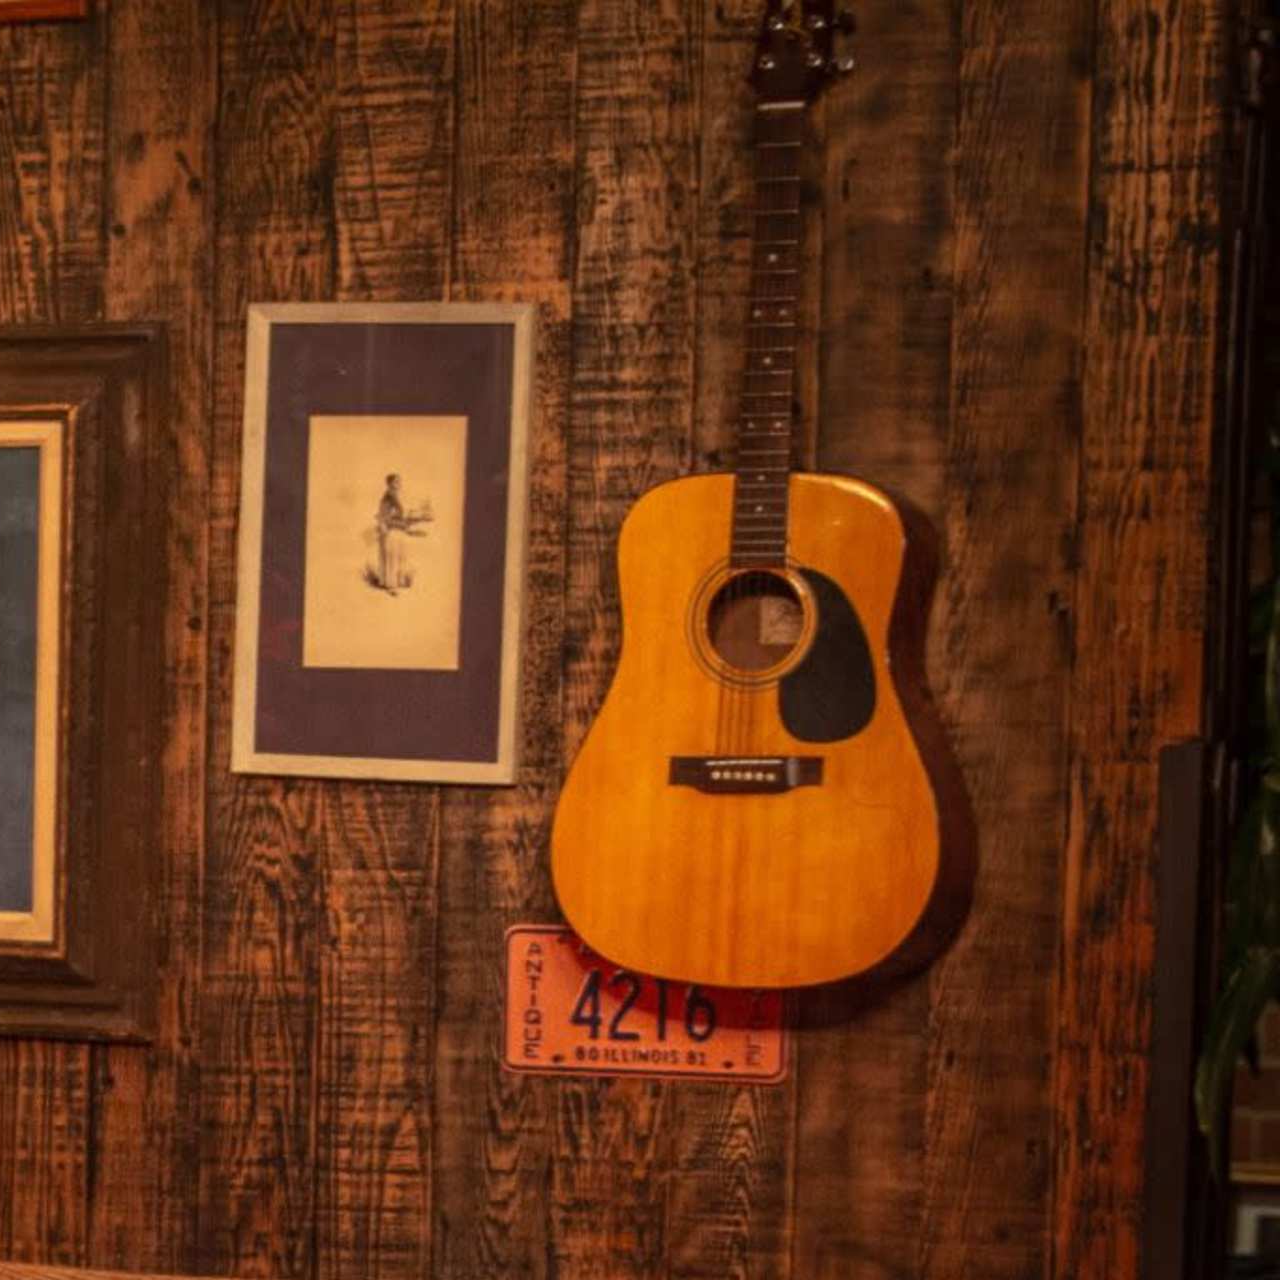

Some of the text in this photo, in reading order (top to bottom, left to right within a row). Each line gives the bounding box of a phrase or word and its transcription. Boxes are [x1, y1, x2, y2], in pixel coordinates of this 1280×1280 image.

[523, 941, 544, 1059] ANTIQUE
[569, 968, 717, 1043] 4216
[603, 1047, 679, 1065] ILLINOIS
